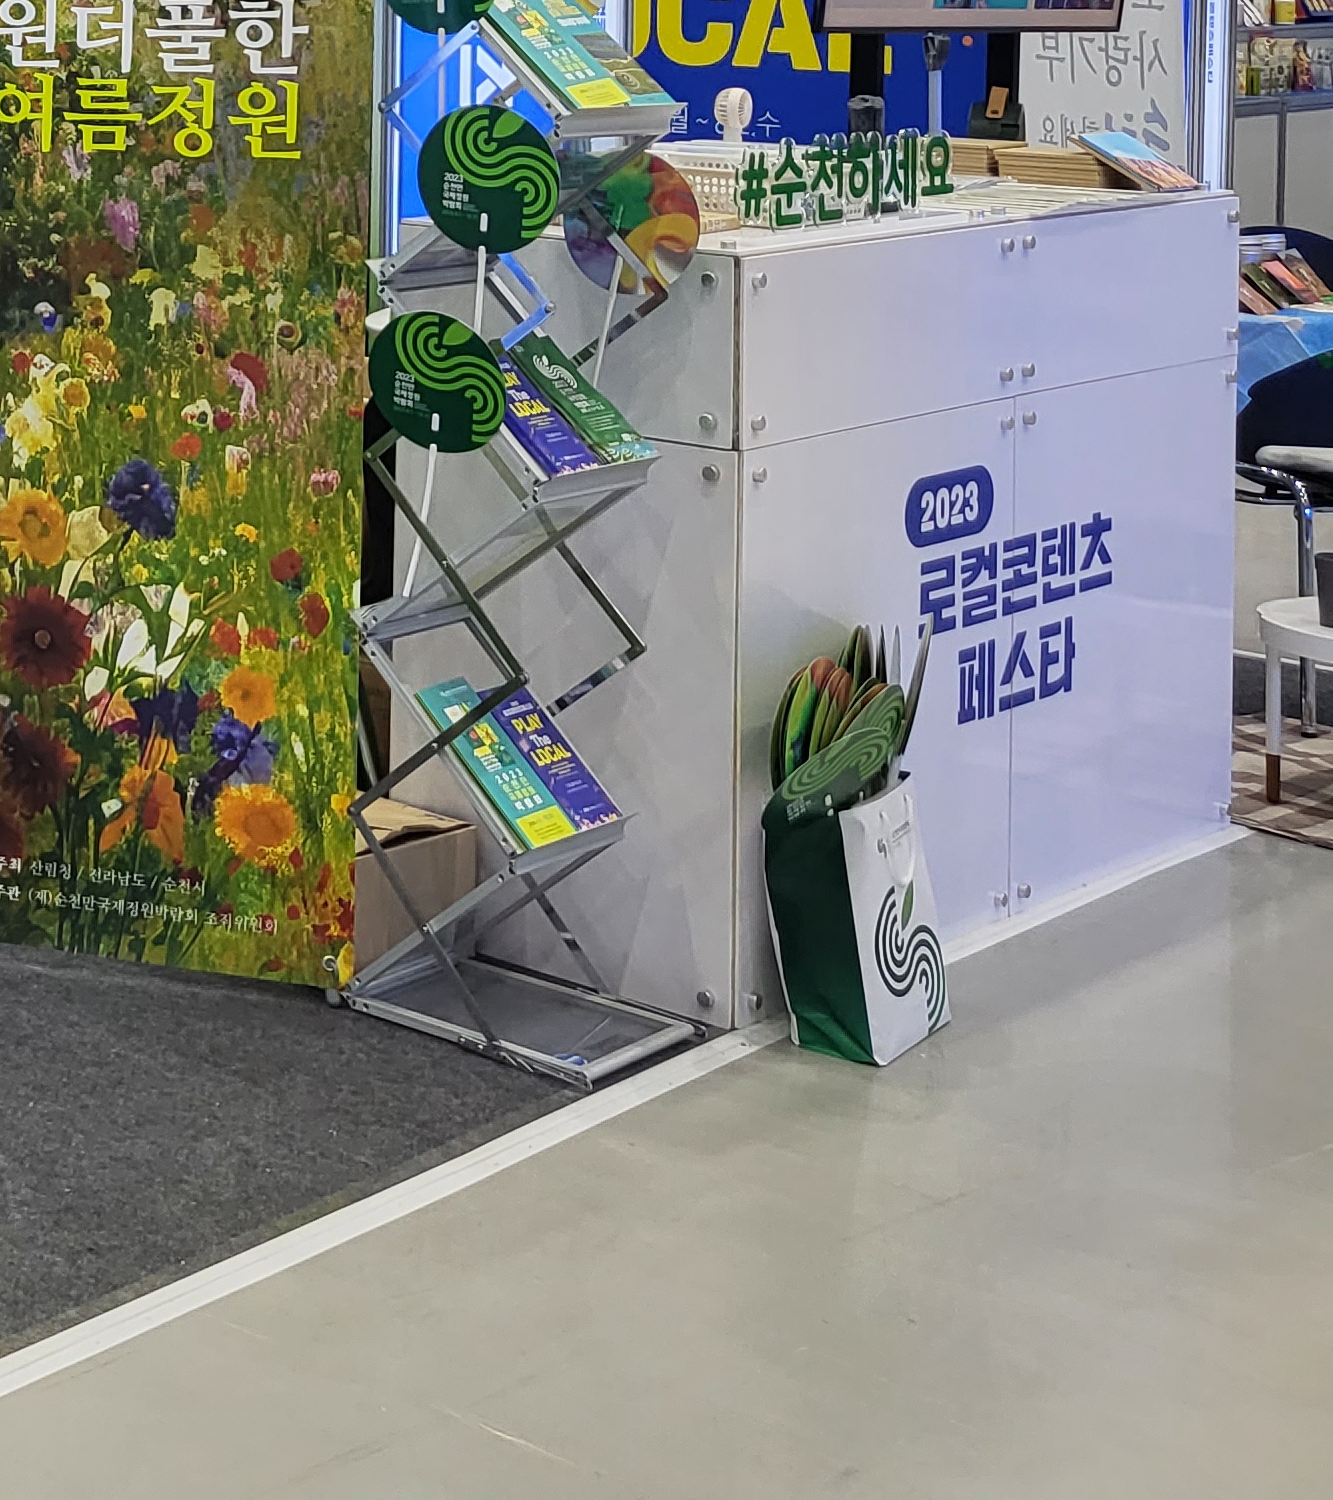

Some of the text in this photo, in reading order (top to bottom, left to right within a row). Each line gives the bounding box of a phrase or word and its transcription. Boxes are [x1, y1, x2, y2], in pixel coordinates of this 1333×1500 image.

[739, 131, 955, 227] #순천하세요
[508, 398, 551, 418] LOCAL
[920, 479, 980, 534] 2023
[918, 511, 1114, 640] 로컬콘텐츠
[957, 615, 1076, 726] 페스타
[510, 712, 544, 735] PLAY
[528, 733, 552, 748] The
[529, 741, 572, 767] LOCAL
